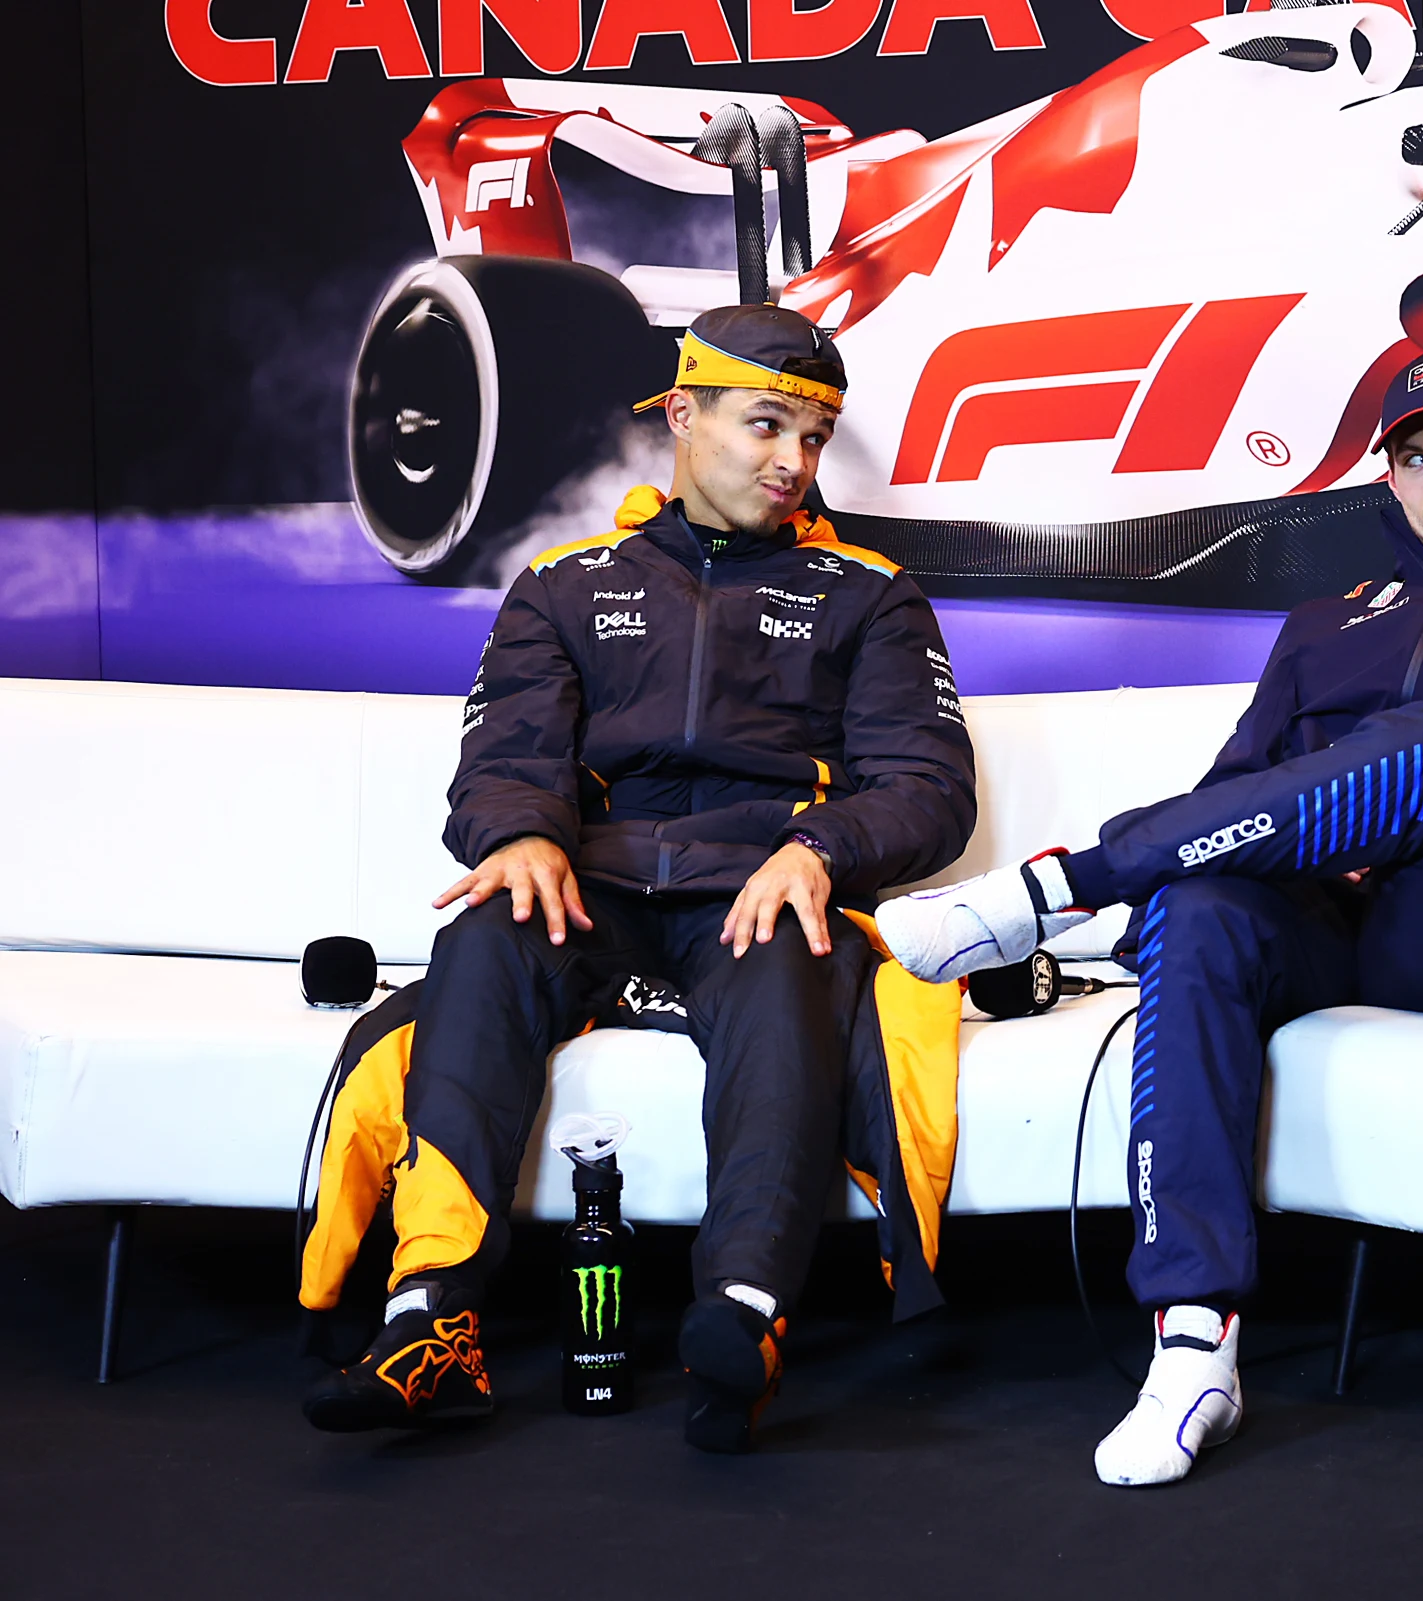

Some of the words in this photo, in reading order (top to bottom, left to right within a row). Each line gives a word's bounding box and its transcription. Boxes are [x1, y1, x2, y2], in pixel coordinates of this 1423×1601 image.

[464, 156, 531, 212] F1
[890, 292, 1308, 486] F1
[755, 586, 817, 605] McLaren
[594, 610, 647, 631] DELL
[759, 613, 813, 640] OKX
[596, 627, 647, 641] Technologies
[1177, 812, 1277, 868] sparco
[1138, 1140, 1157, 1245] sparco
[573, 1351, 626, 1364] MONSTER
[586, 1387, 613, 1401] LN4
